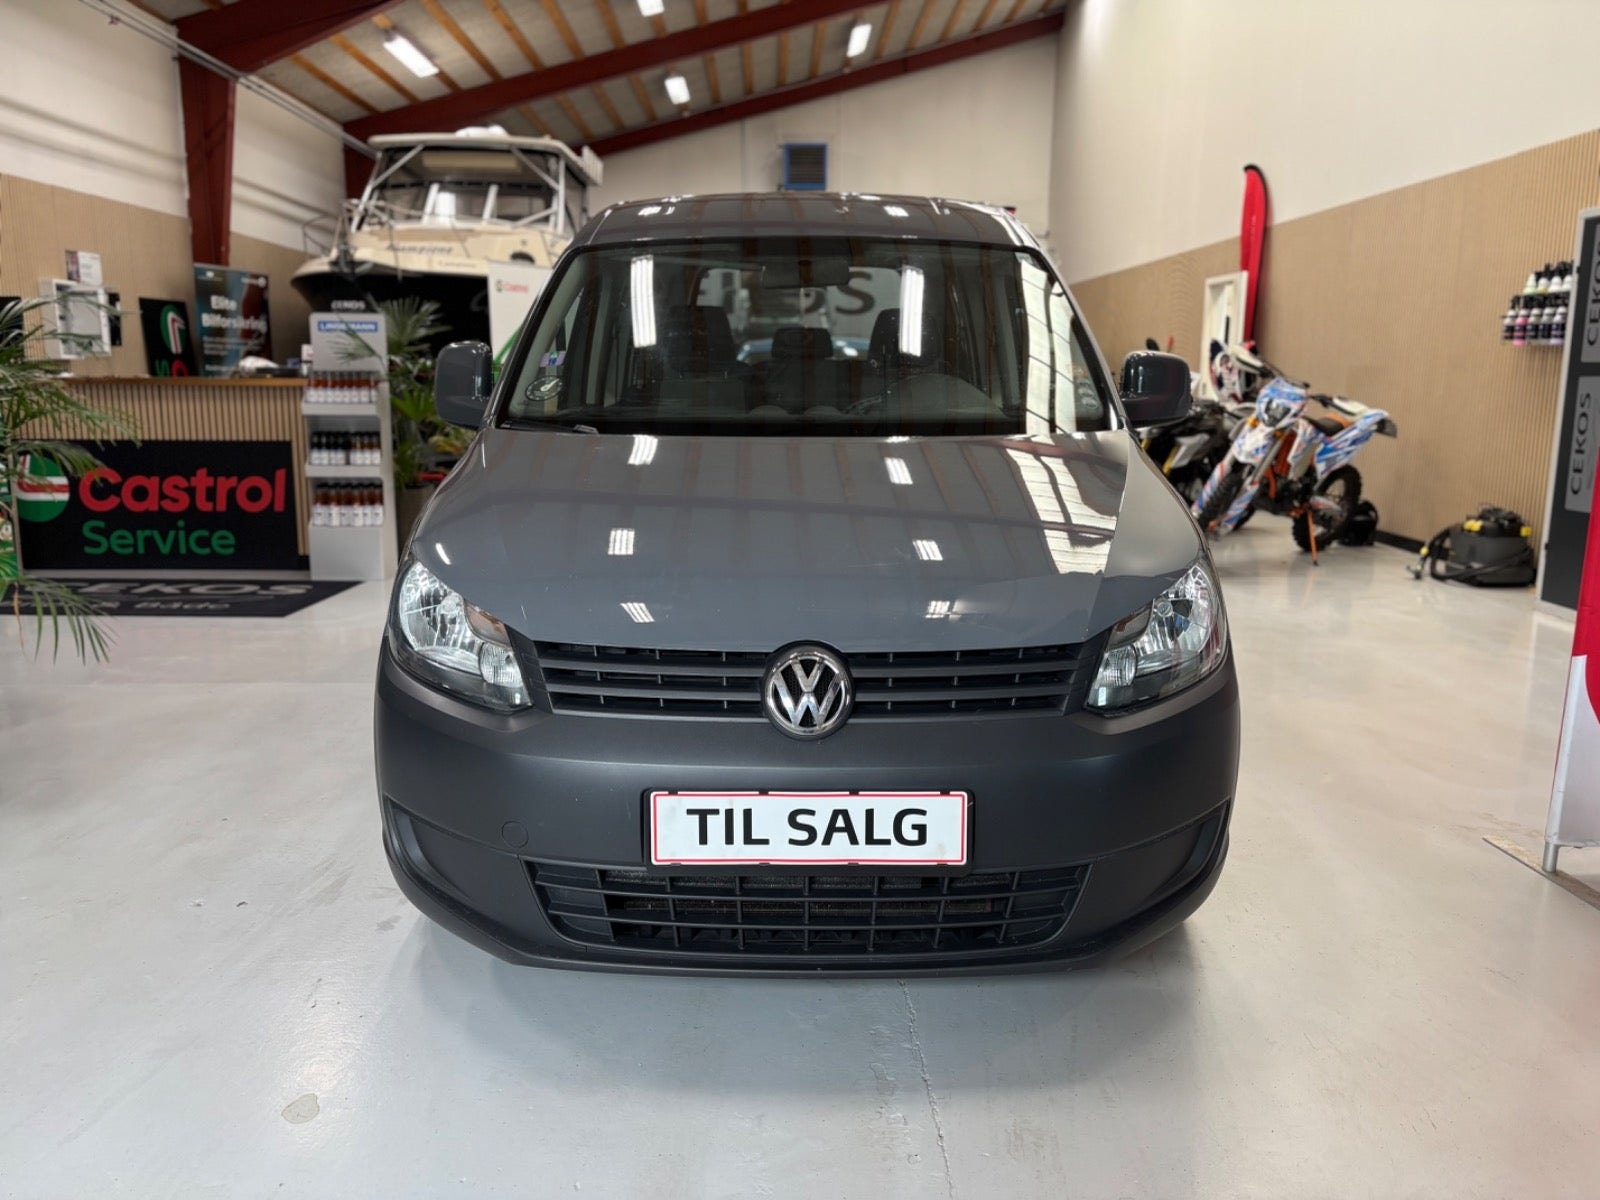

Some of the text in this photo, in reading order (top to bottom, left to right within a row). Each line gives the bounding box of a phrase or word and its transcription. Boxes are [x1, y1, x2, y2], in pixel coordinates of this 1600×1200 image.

[1570, 392, 1591, 495] CEKOS
[79, 467, 287, 512] Castrol
[82, 519, 236, 555] Service
[686, 807, 928, 847] TIL SALG
